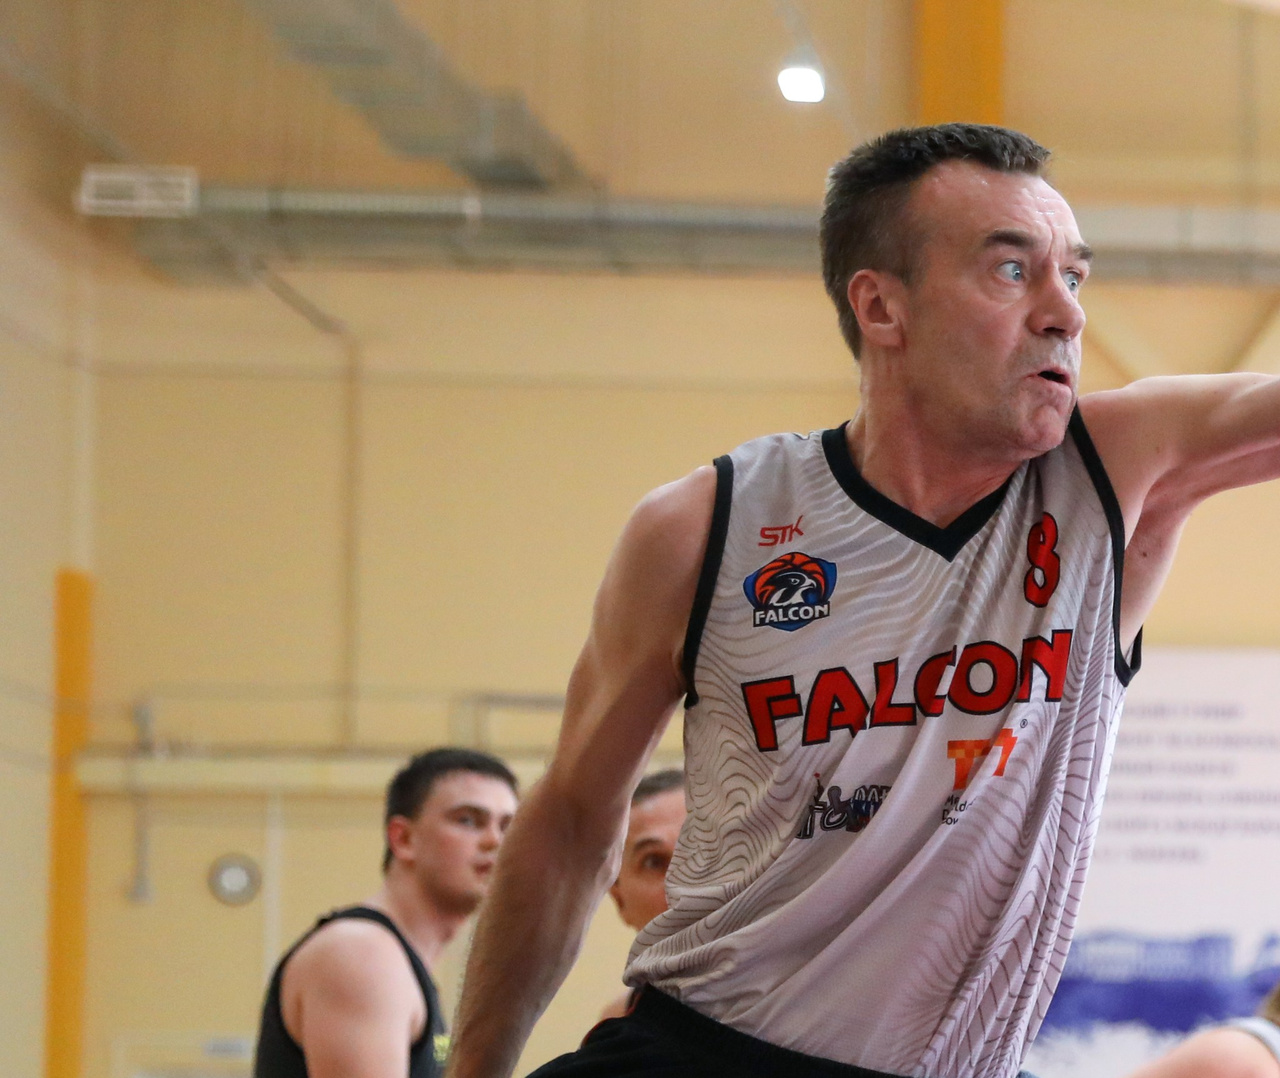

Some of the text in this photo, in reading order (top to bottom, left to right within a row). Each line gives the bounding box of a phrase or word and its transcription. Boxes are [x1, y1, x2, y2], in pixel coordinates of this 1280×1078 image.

[758, 515, 804, 546] STK
[1023, 511, 1061, 608] 8
[755, 604, 829, 625] FALCON
[741, 629, 1073, 752] FALCON
